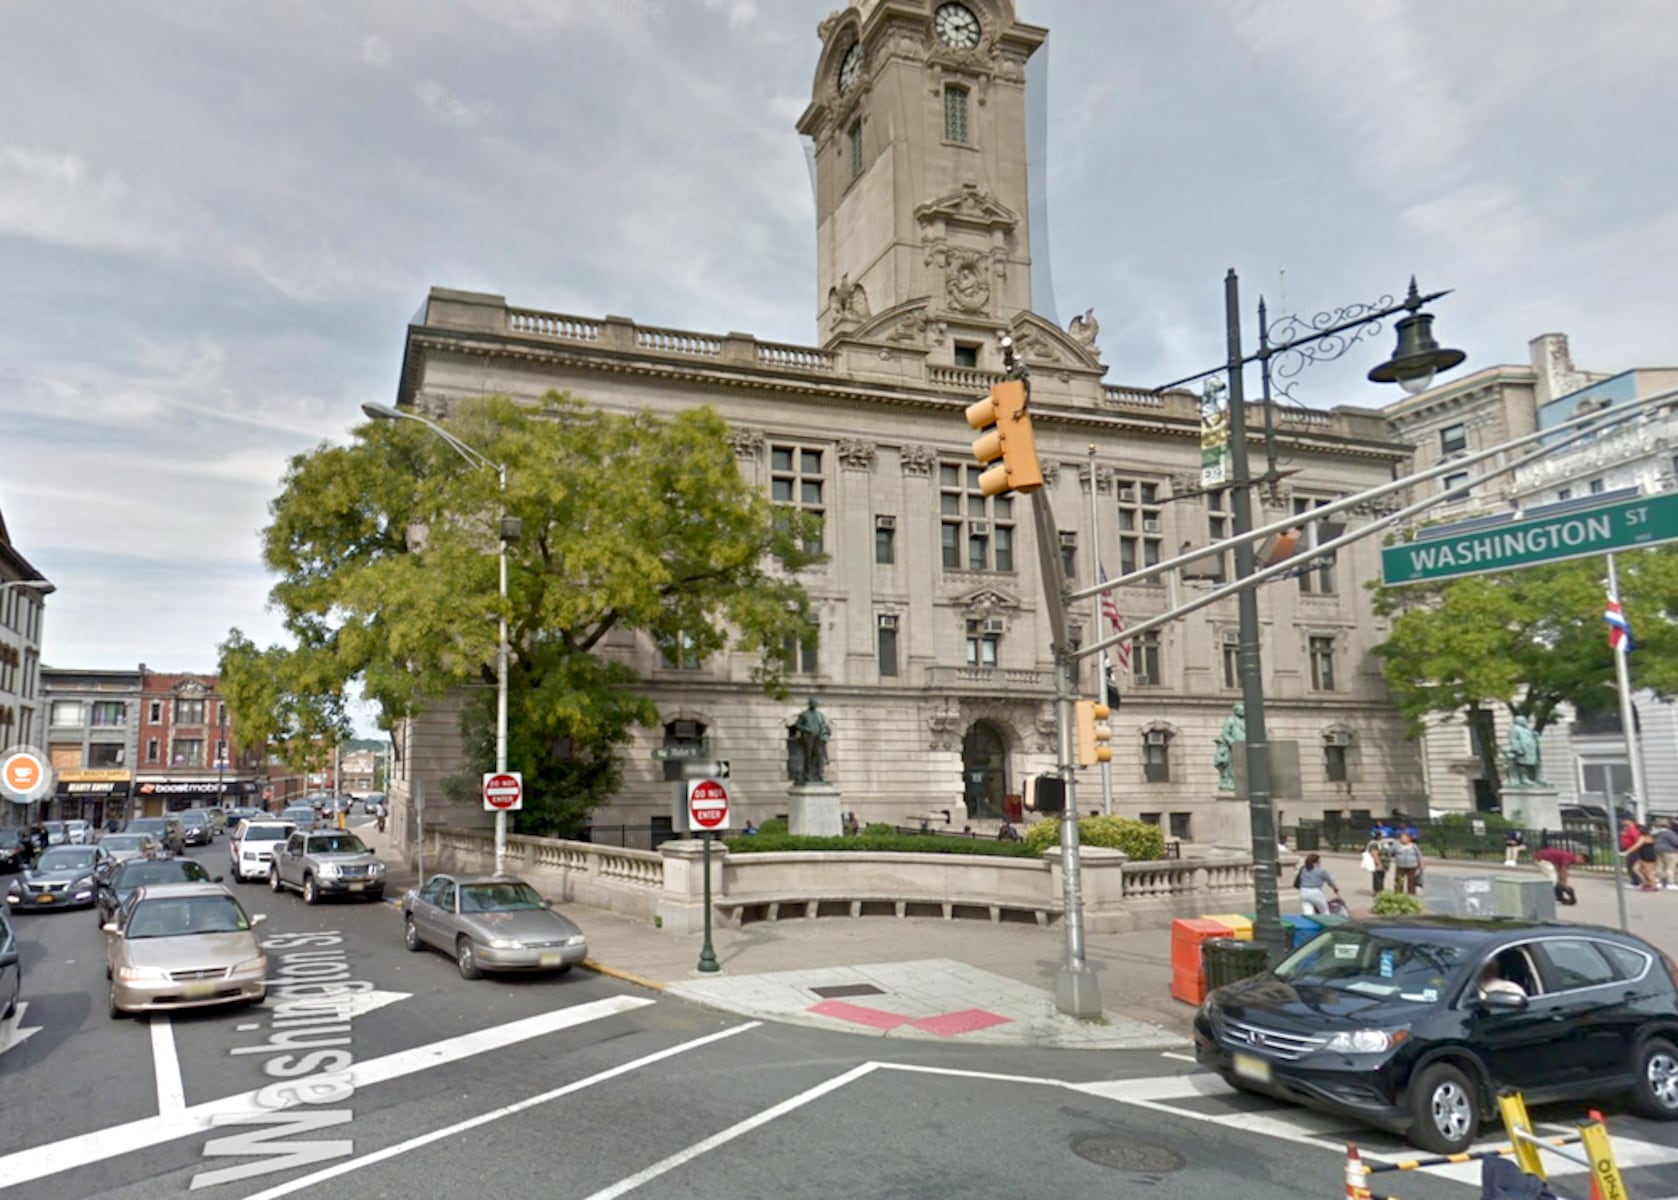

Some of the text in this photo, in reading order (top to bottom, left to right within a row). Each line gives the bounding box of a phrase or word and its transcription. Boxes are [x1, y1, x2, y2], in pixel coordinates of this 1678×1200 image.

[1410, 507, 1648, 571] WASHINGTON ST
[695, 789, 723, 798] DO NOT
[697, 810, 721, 820] ENTER
